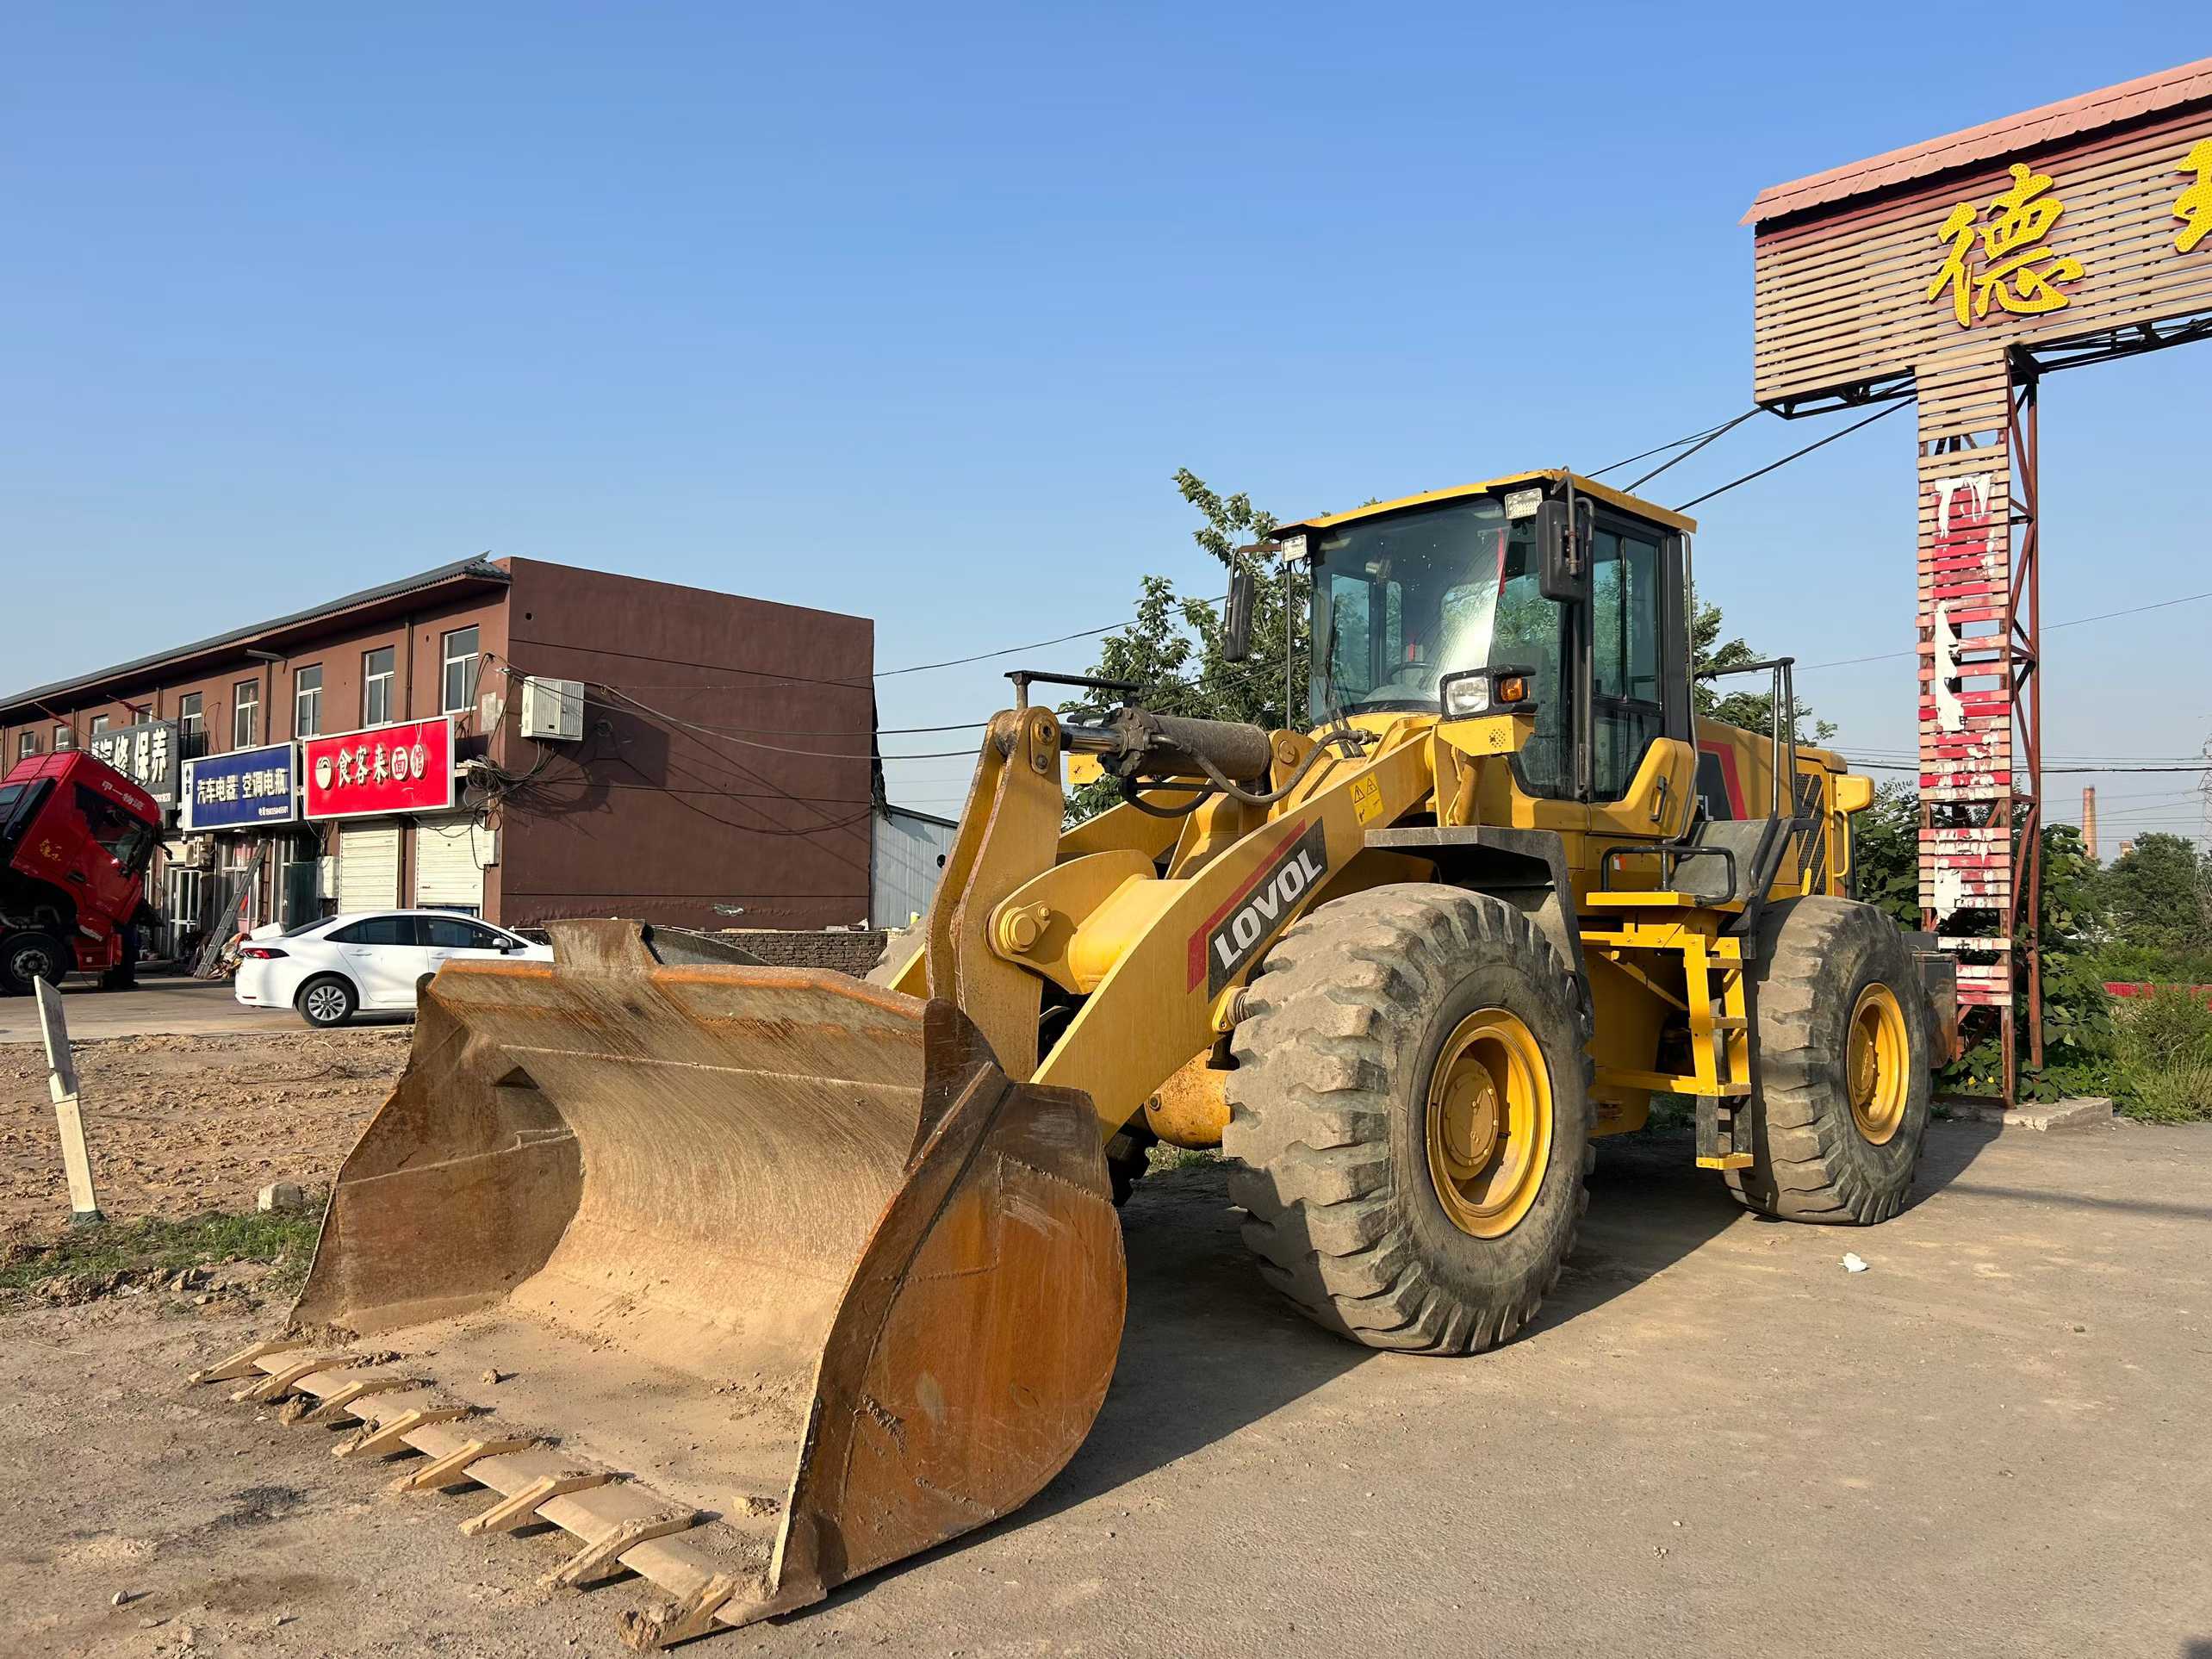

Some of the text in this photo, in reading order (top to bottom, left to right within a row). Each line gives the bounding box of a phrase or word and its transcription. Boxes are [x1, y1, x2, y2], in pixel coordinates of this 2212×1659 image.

[197, 774, 239, 805] 汽车电器
[242, 767, 289, 798] 空调电瓶
[337, 743, 425, 787] 食客来面馆
[1214, 848, 1323, 970] LOVOL
